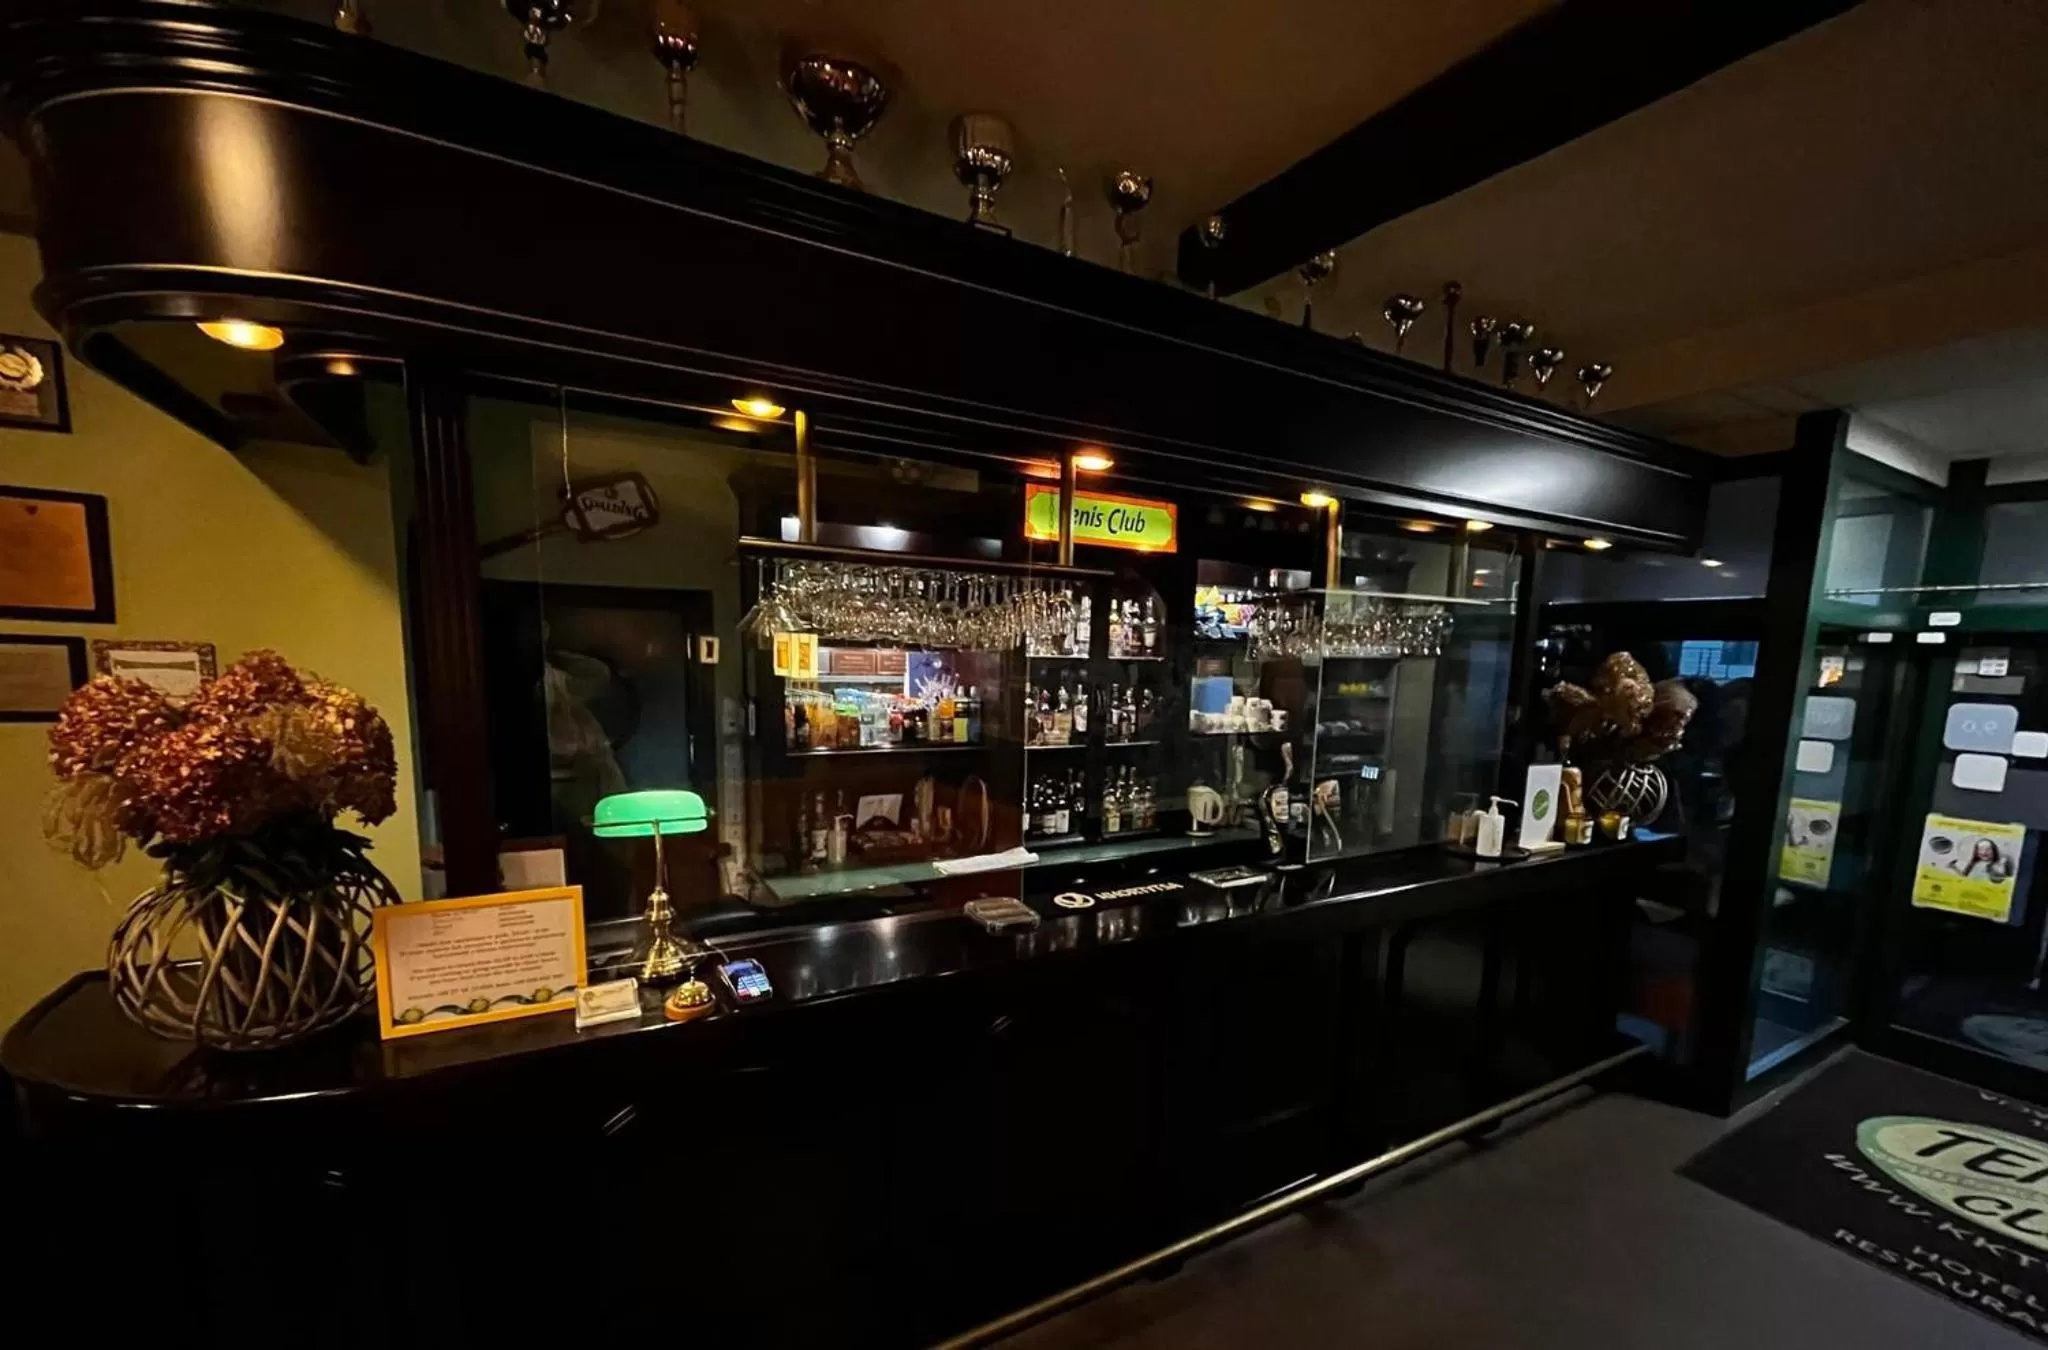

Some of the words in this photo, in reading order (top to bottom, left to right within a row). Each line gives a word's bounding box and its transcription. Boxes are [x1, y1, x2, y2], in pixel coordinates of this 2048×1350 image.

[1073, 505, 1104, 528] enis
[1108, 508, 1146, 534] Club
[1824, 1152, 2048, 1269] WWW.KKT
[1912, 1245, 2046, 1313] HOTEL
